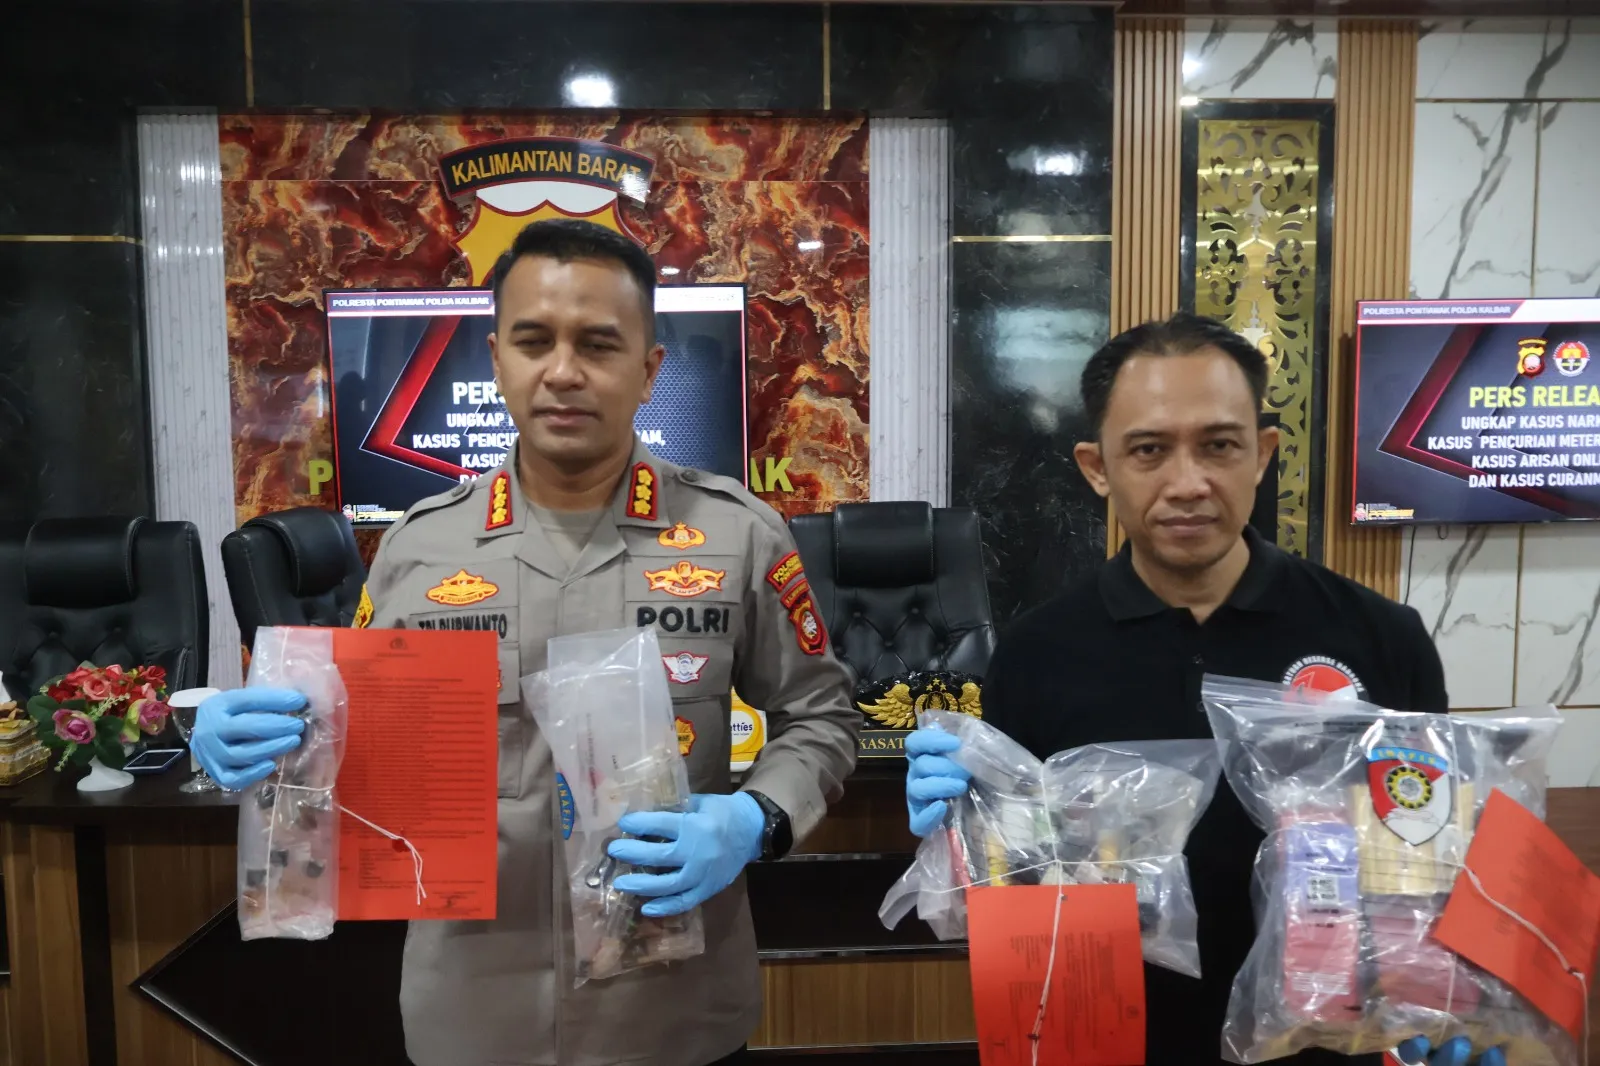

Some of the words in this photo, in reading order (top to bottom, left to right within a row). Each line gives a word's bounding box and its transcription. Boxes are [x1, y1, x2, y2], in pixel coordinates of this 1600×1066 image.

[452, 151, 572, 186] KALIMANTAN
[333, 299, 376, 307] POLRESTA
[425, 297, 454, 305] POLDA
[1363, 307, 1405, 315] POLRESTA
[1451, 306, 1477, 314] POLDA
[452, 381, 507, 405] PER
[1469, 386, 1526, 408] PERS
[1533, 385, 1600, 407] RELEA
[446, 412, 505, 428] UNGKAP
[1461, 415, 1517, 430] UNGKAP
[1519, 415, 1564, 429] KASUS
[412, 434, 461, 449] KASUS
[468, 432, 520, 447] PENCU
[1427, 436, 1473, 450] KASUS
[1480, 434, 1556, 449] PENCURIAN
[1471, 454, 1517, 469] KASUS
[1519, 453, 1570, 468] ARISAN
[1468, 474, 1498, 488] DAN
[1500, 473, 1545, 488] KASUS
[637, 606, 730, 634] POLRI
[858, 737, 906, 750] KASAT
